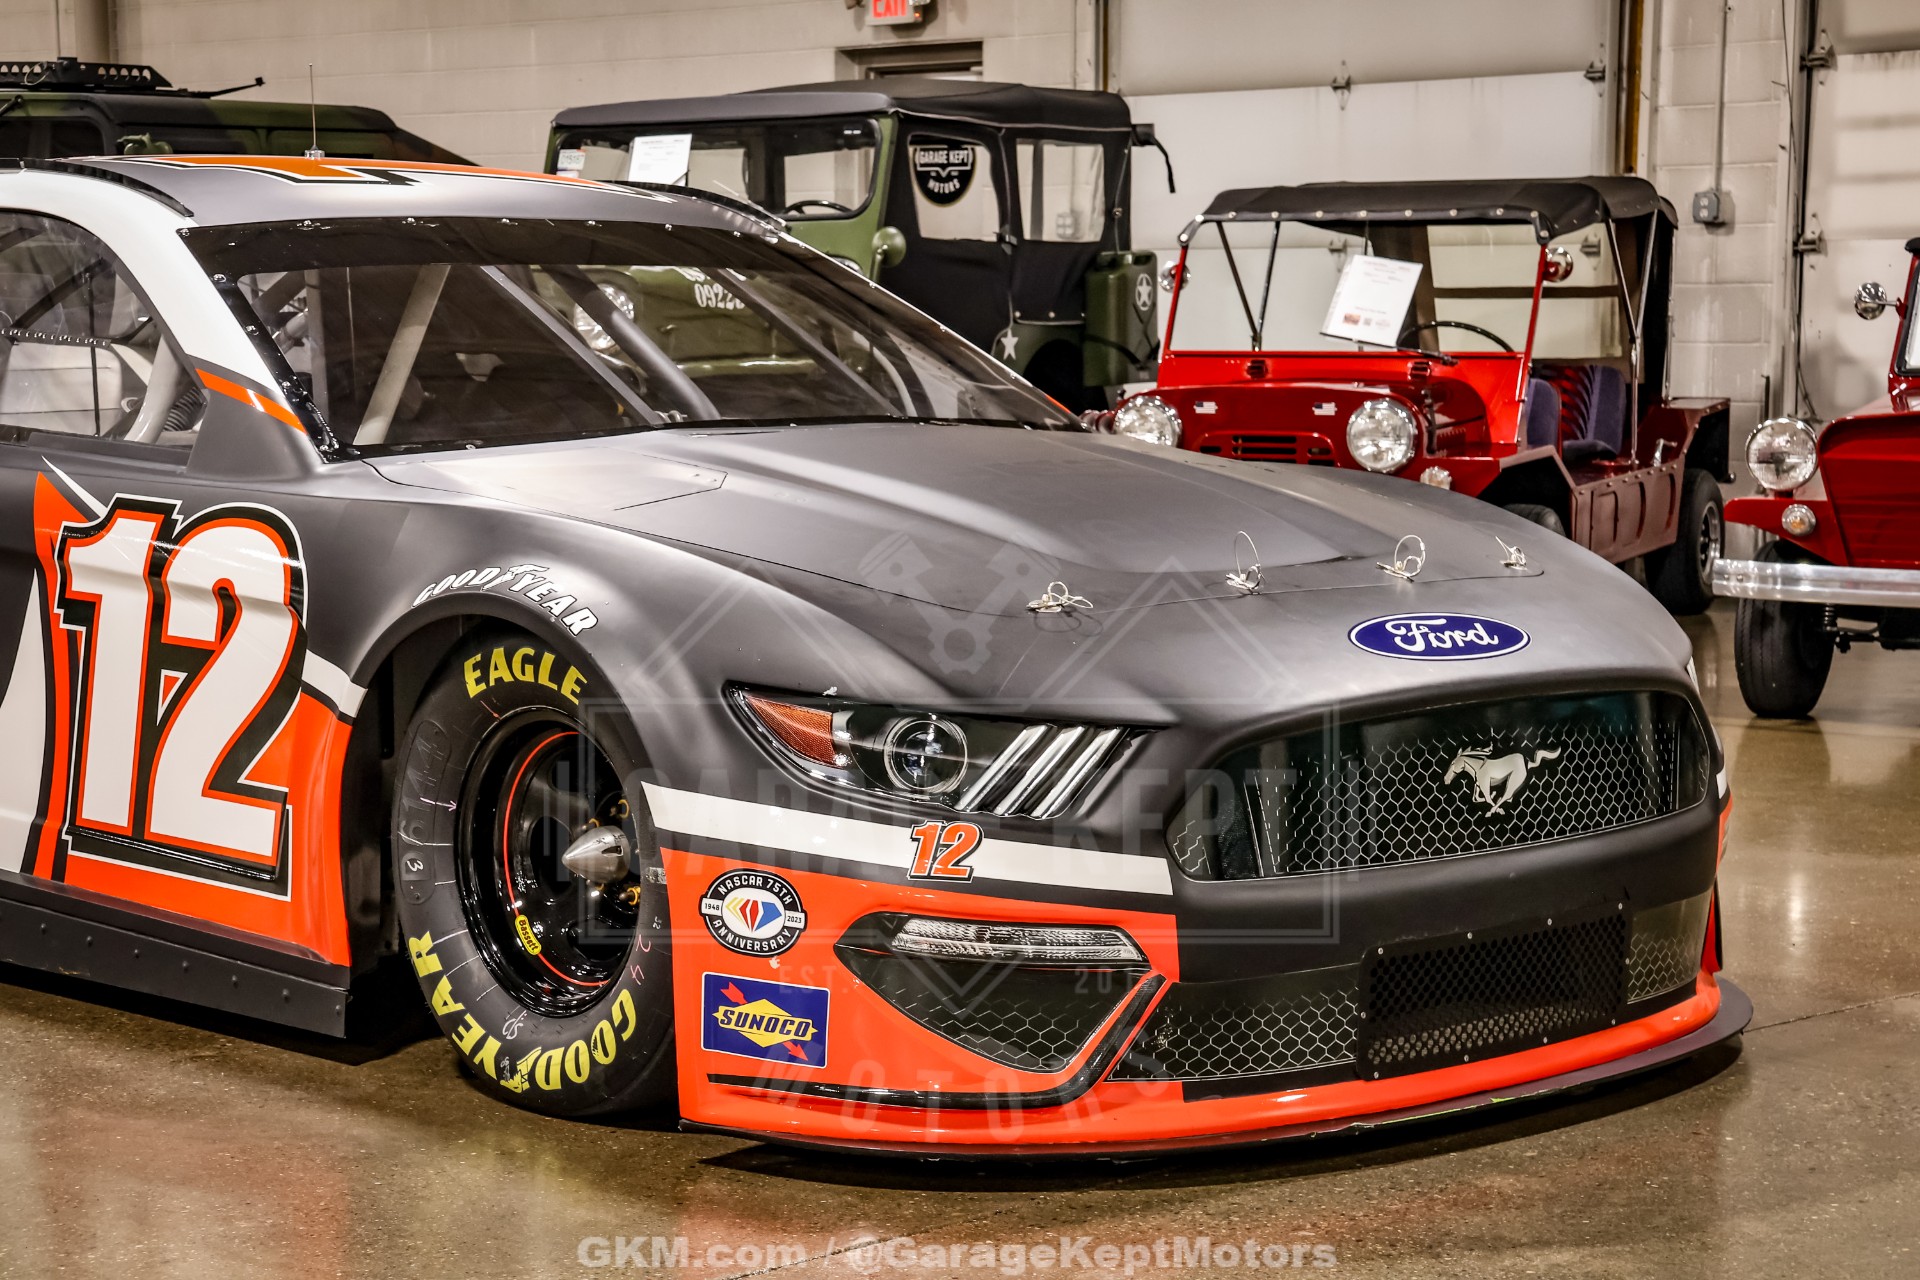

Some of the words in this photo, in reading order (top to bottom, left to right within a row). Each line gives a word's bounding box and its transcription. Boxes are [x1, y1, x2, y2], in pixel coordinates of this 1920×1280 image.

[949, 150, 968, 163] KEPT
[411, 563, 599, 637] GOODYEAR
[1385, 618, 1499, 652] Ford
[463, 647, 588, 706] EAGLE
[58, 497, 303, 892] 12
[907, 820, 984, 883] 12
[704, 902, 720, 911] 1948
[717, 875, 763, 896] NASCAR
[765, 877, 793, 905] 75TH
[518, 918, 539, 952] Bassett
[712, 919, 791, 952] ANNIVERSARY
[786, 915, 803, 924] 2023
[408, 931, 637, 1092] GOODYEAR
[719, 1009, 811, 1038] SUNOCO
